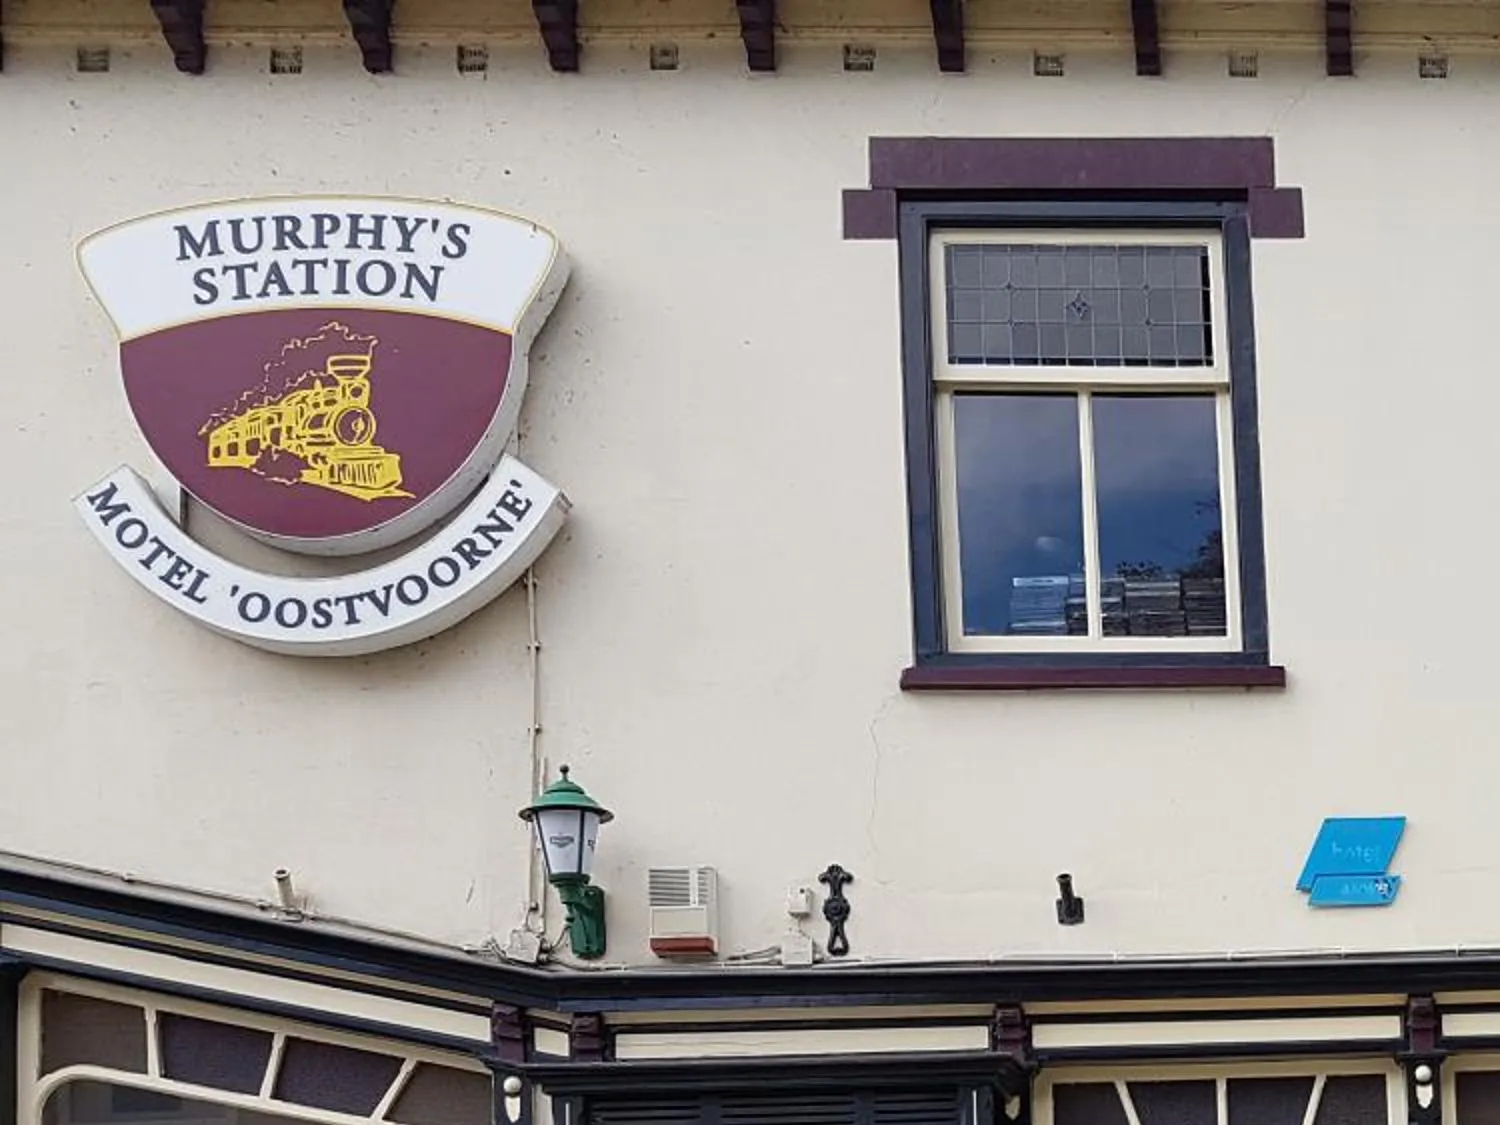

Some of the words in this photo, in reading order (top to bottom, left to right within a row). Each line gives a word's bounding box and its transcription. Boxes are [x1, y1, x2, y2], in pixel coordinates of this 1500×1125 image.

[173, 213, 471, 261] MURPHY'S
[192, 259, 445, 305] STATION
[86, 481, 210, 605] MOTEL
[229, 478, 534, 630] 'OOSTVOORNE'
